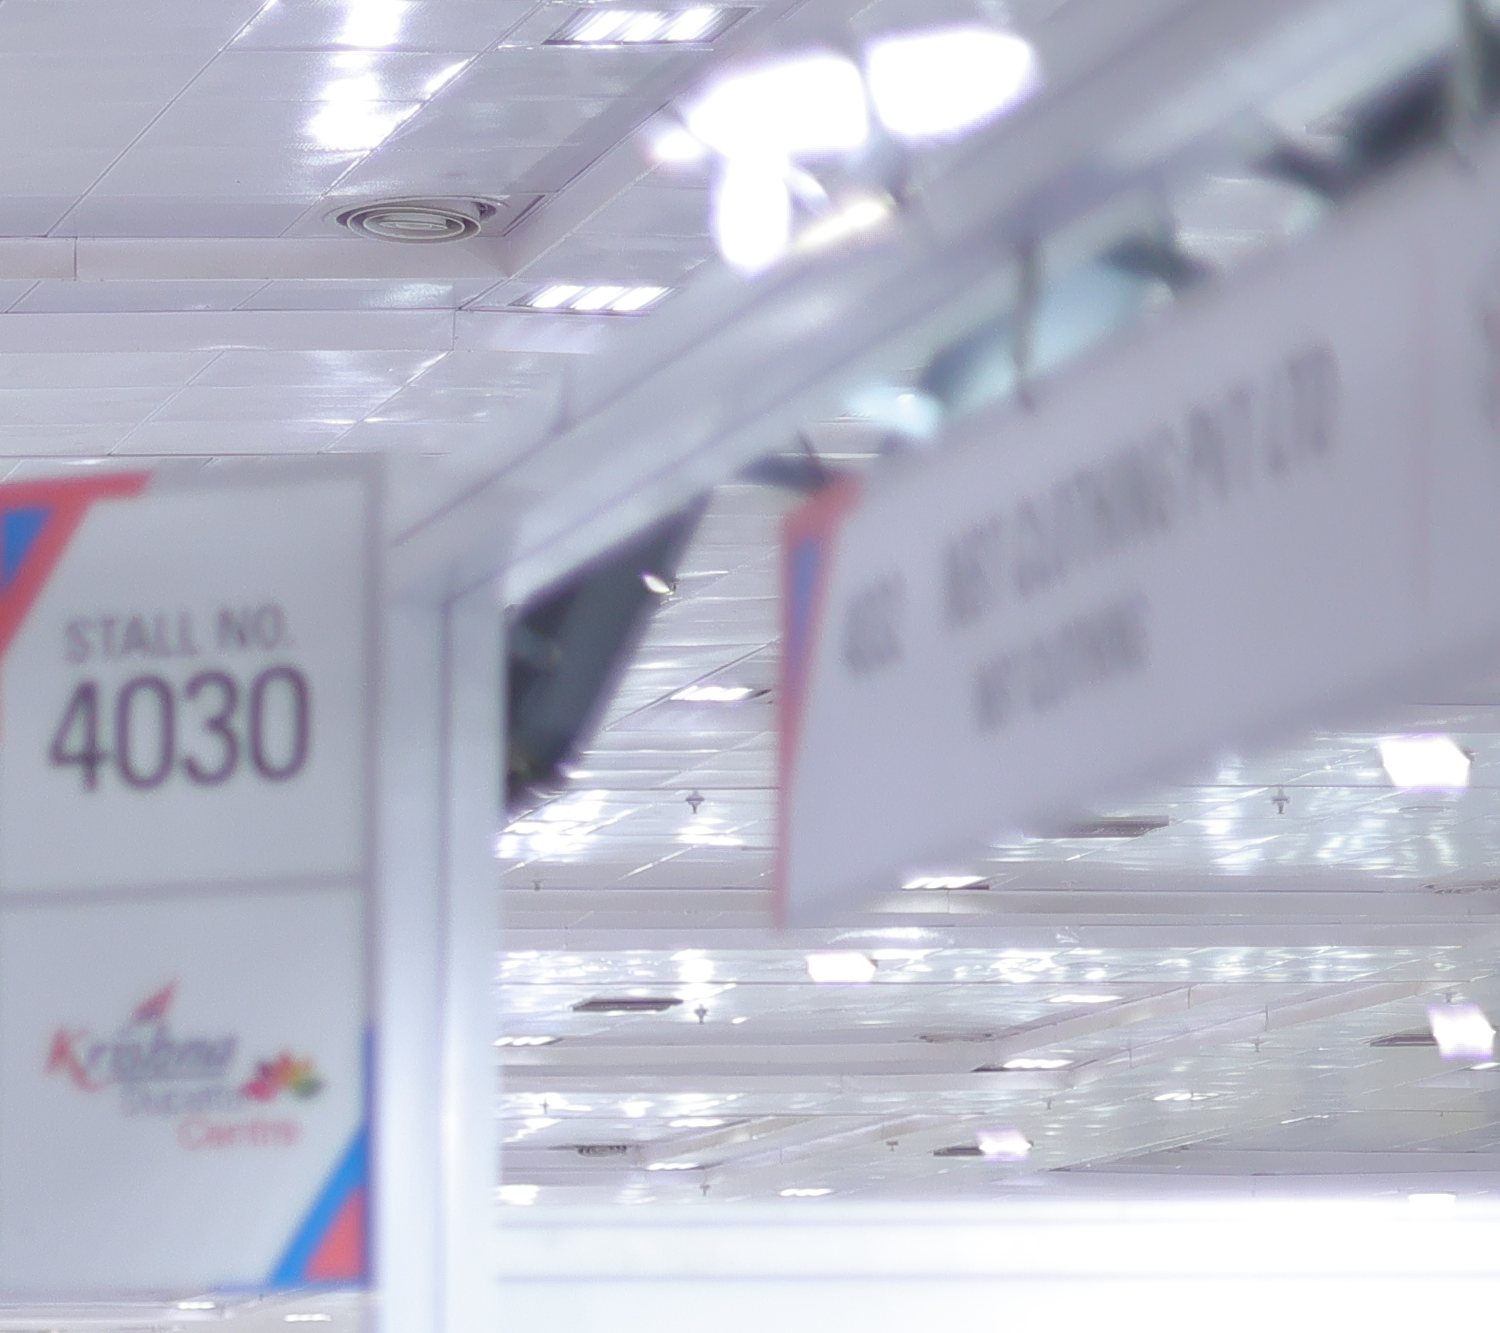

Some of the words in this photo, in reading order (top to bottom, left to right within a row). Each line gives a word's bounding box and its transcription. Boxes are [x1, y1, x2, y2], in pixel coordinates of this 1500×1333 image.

[65, 613, 197, 665] STALL
[215, 600, 293, 659] NO.
[49, 663, 313, 795] 4030
